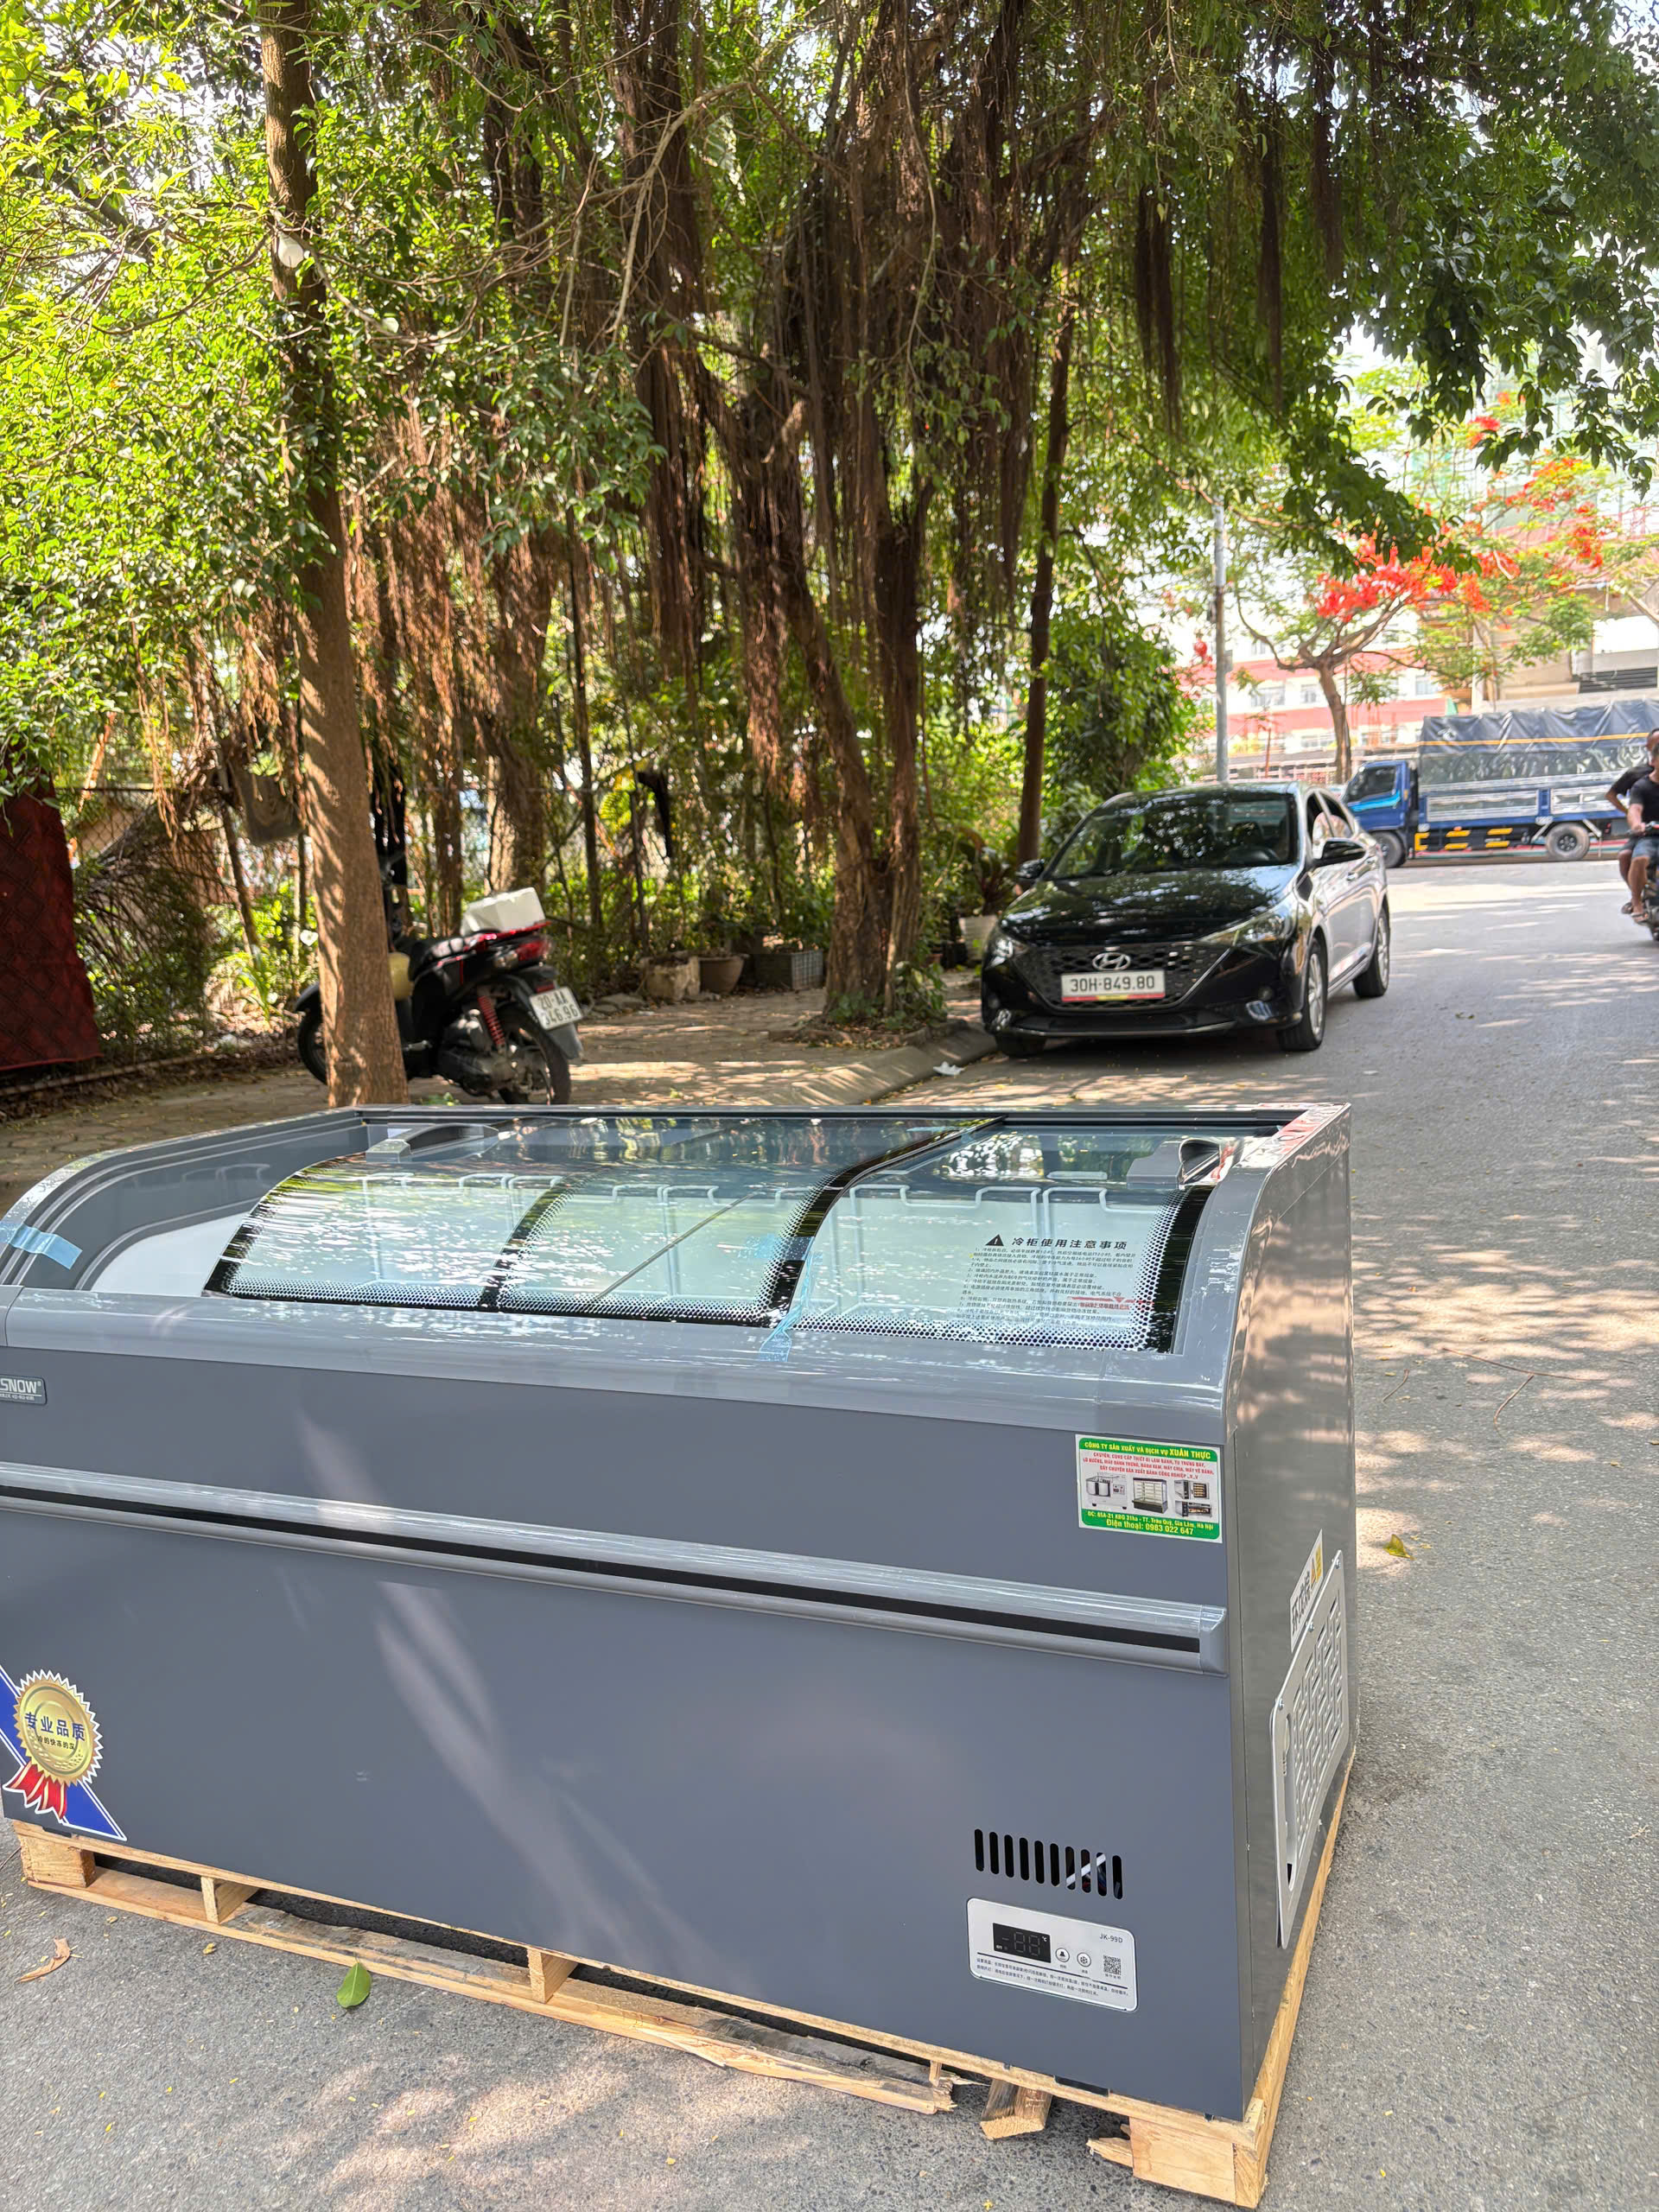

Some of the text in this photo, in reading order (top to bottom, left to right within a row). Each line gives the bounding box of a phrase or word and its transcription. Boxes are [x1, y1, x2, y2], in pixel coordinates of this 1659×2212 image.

[1070, 975, 1155, 993] 30H-849.80
[1012, 1237, 1128, 1249] 冷柜使用注意事项
[1169, 1447, 1189, 1457] XUÂN
[1106, 1518, 1122, 1529] Điện
[1123, 1520, 1144, 1530] thoại:
[1145, 1522, 1163, 1532] 0983
[1179, 1527, 1194, 1535] 647
[24, 1712, 86, 1742] 专业品质
[1099, 1933, 1123, 1943] JK-99D
